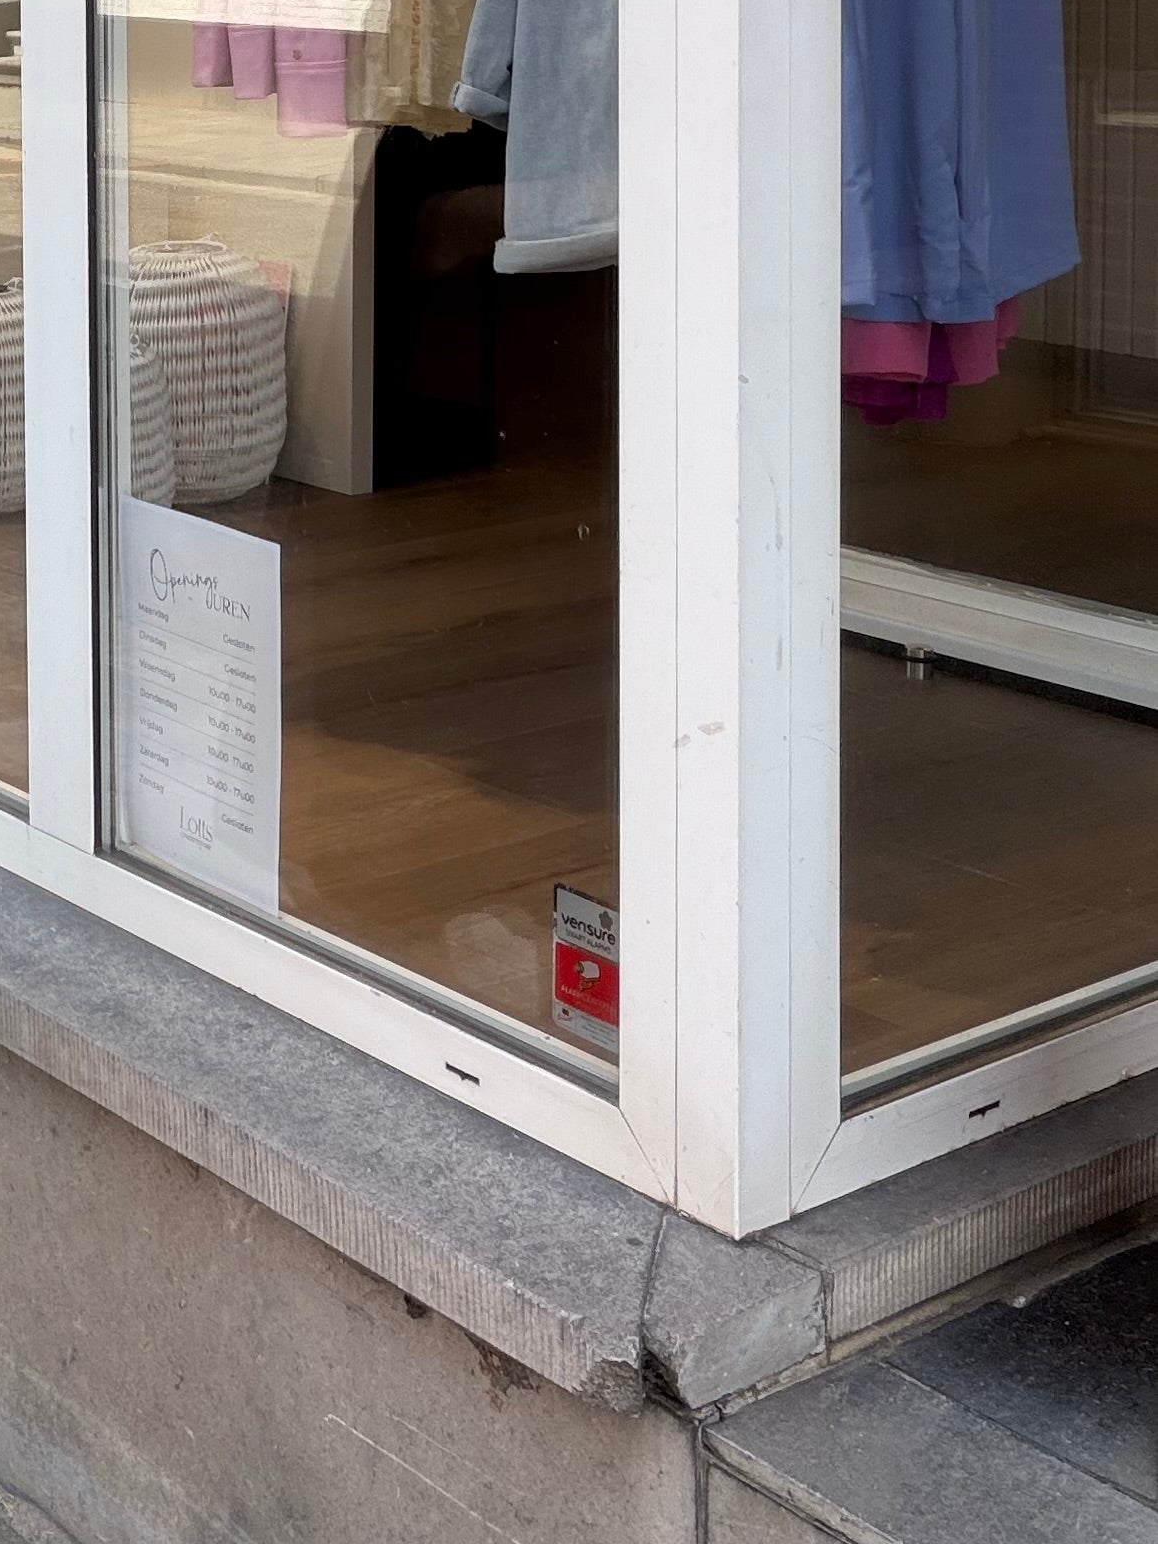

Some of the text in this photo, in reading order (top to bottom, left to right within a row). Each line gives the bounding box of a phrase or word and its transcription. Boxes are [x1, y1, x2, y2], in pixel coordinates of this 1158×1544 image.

[149, 548, 219, 610] Openings
[213, 593, 251, 621] UREN
[138, 602, 256, 654] Maandag Gesloten
[139, 630, 257, 683] Dinsdag Gesloten
[139, 657, 176, 683] Woensdag
[140, 687, 178, 712] Donderdag
[139, 715, 164, 735] Vrijdag
[139, 743, 170, 768] Zaterdag
[138, 773, 165, 795] Zondag
